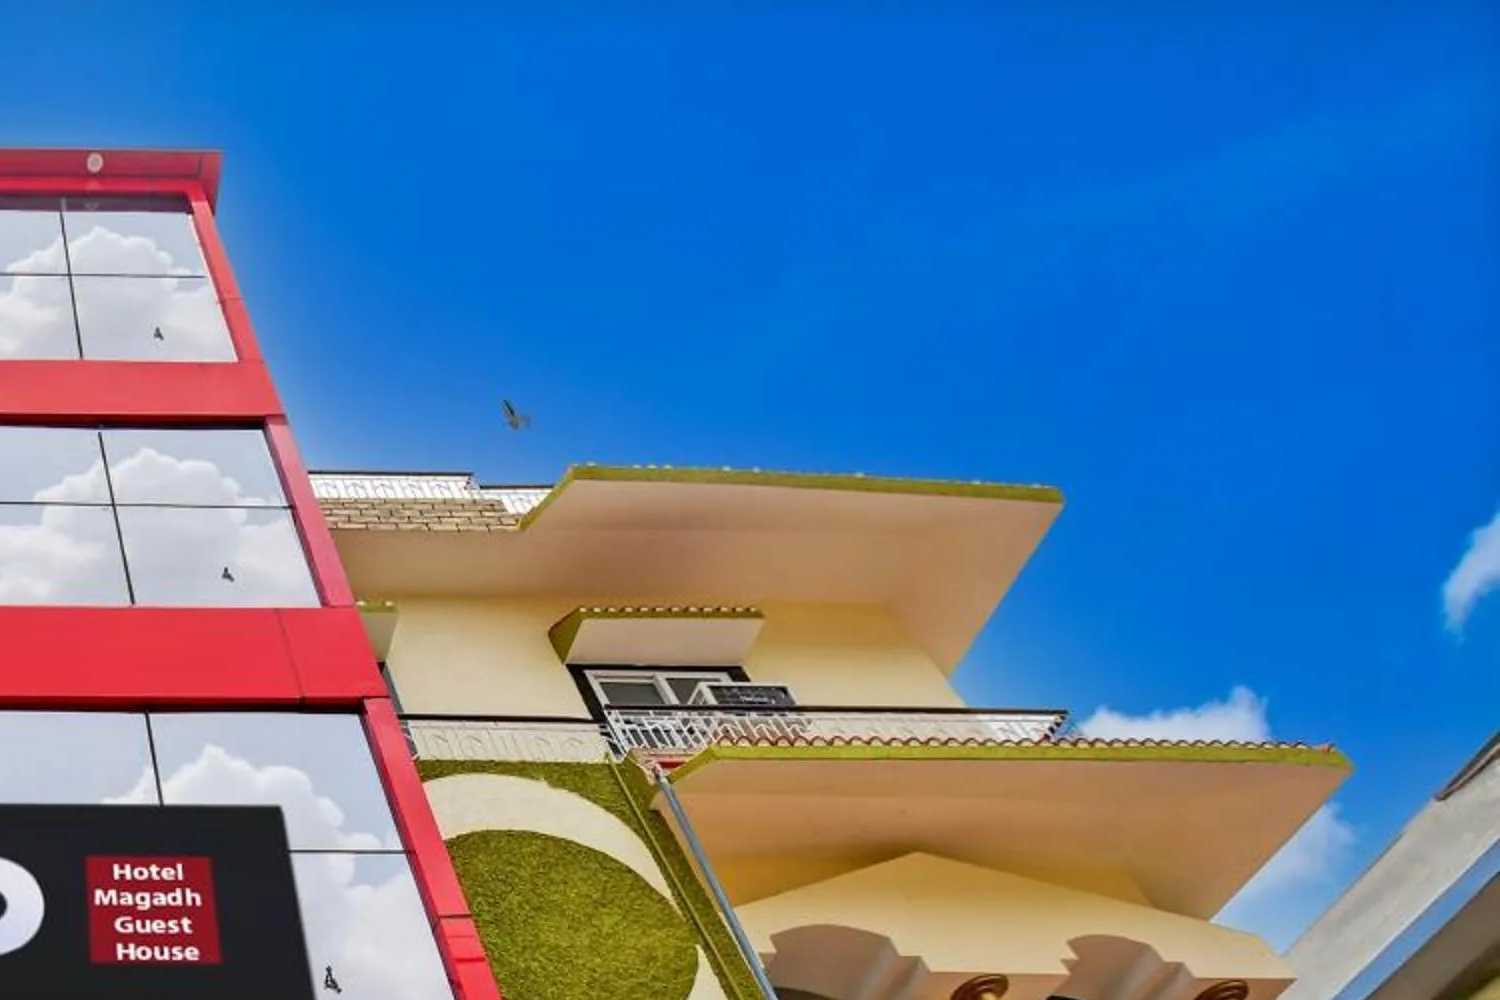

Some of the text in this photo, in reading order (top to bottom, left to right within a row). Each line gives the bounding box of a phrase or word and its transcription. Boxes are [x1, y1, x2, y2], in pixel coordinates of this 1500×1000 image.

[112, 863, 184, 881] Hotel
[93, 887, 202, 911] Magadh
[114, 916, 193, 934] Guest
[116, 943, 200, 961] House
